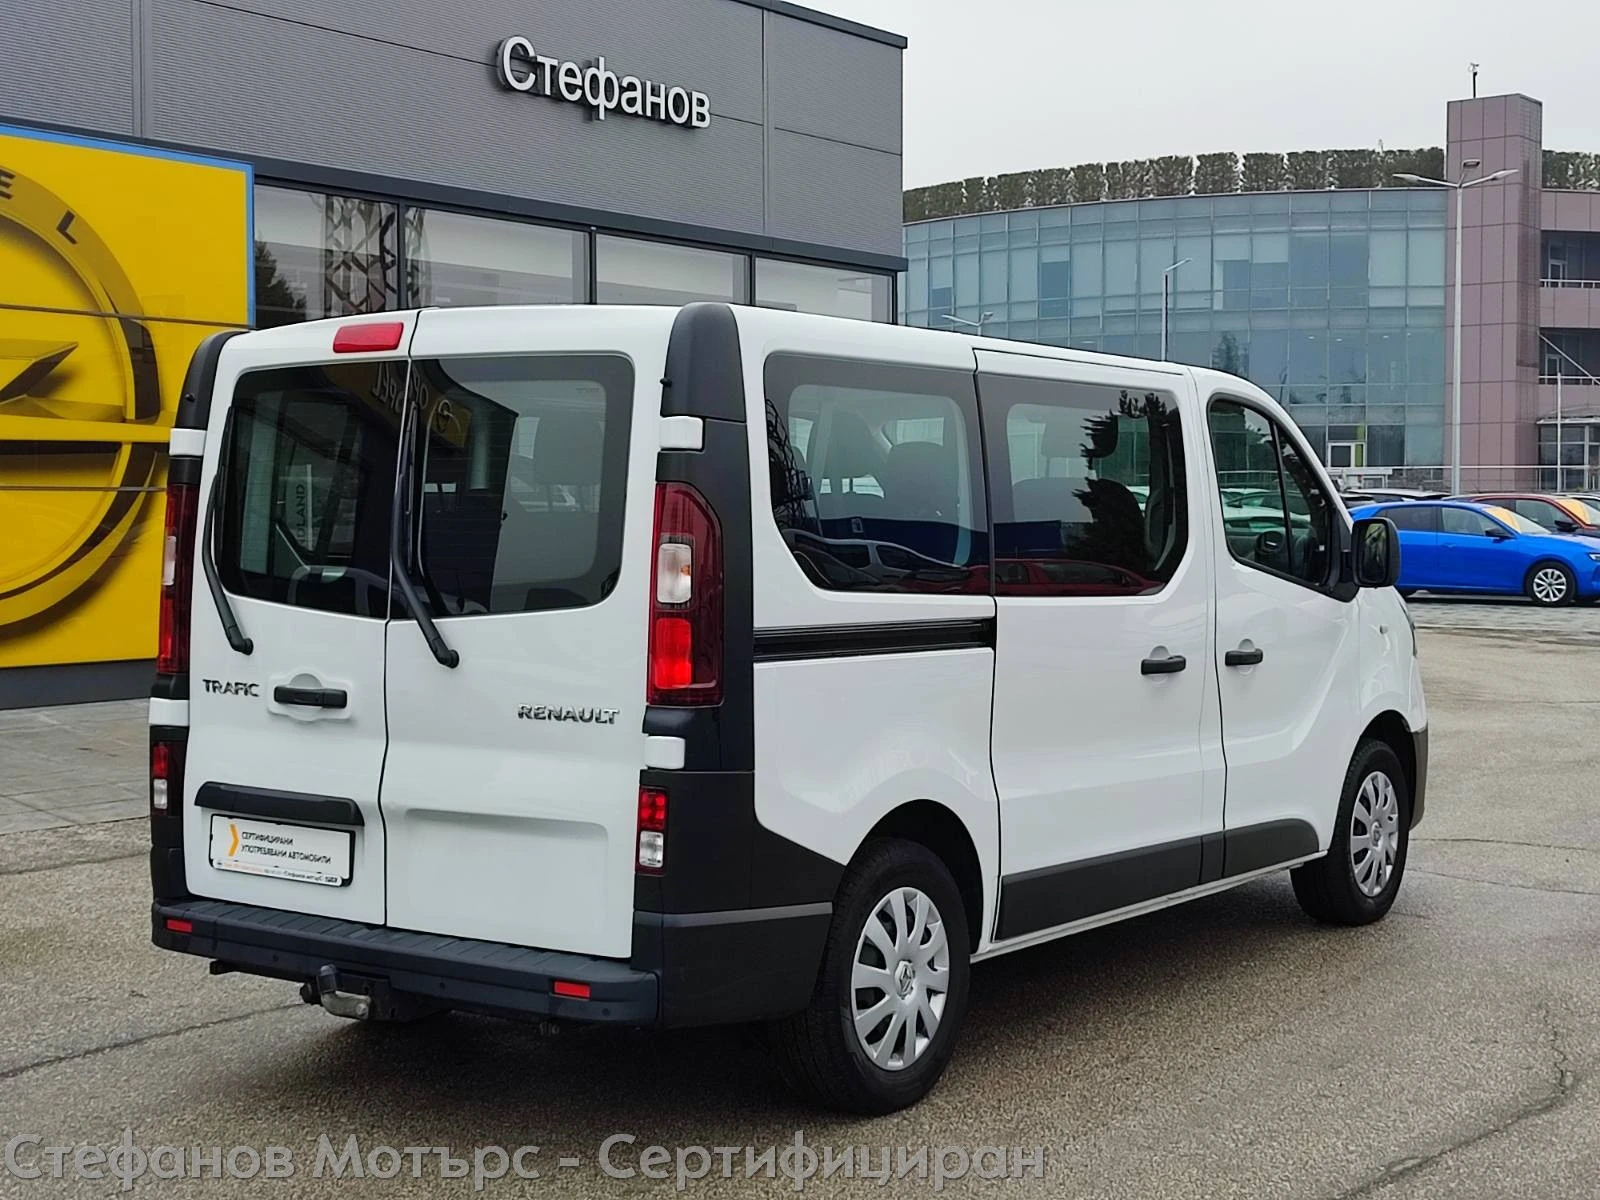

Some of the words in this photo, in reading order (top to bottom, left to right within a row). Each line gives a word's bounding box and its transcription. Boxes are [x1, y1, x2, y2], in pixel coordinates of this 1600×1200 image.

[499, 35, 711, 128] Стефанов
[202, 678, 260, 697] TRAFIC
[517, 703, 620, 725] RENAULT
